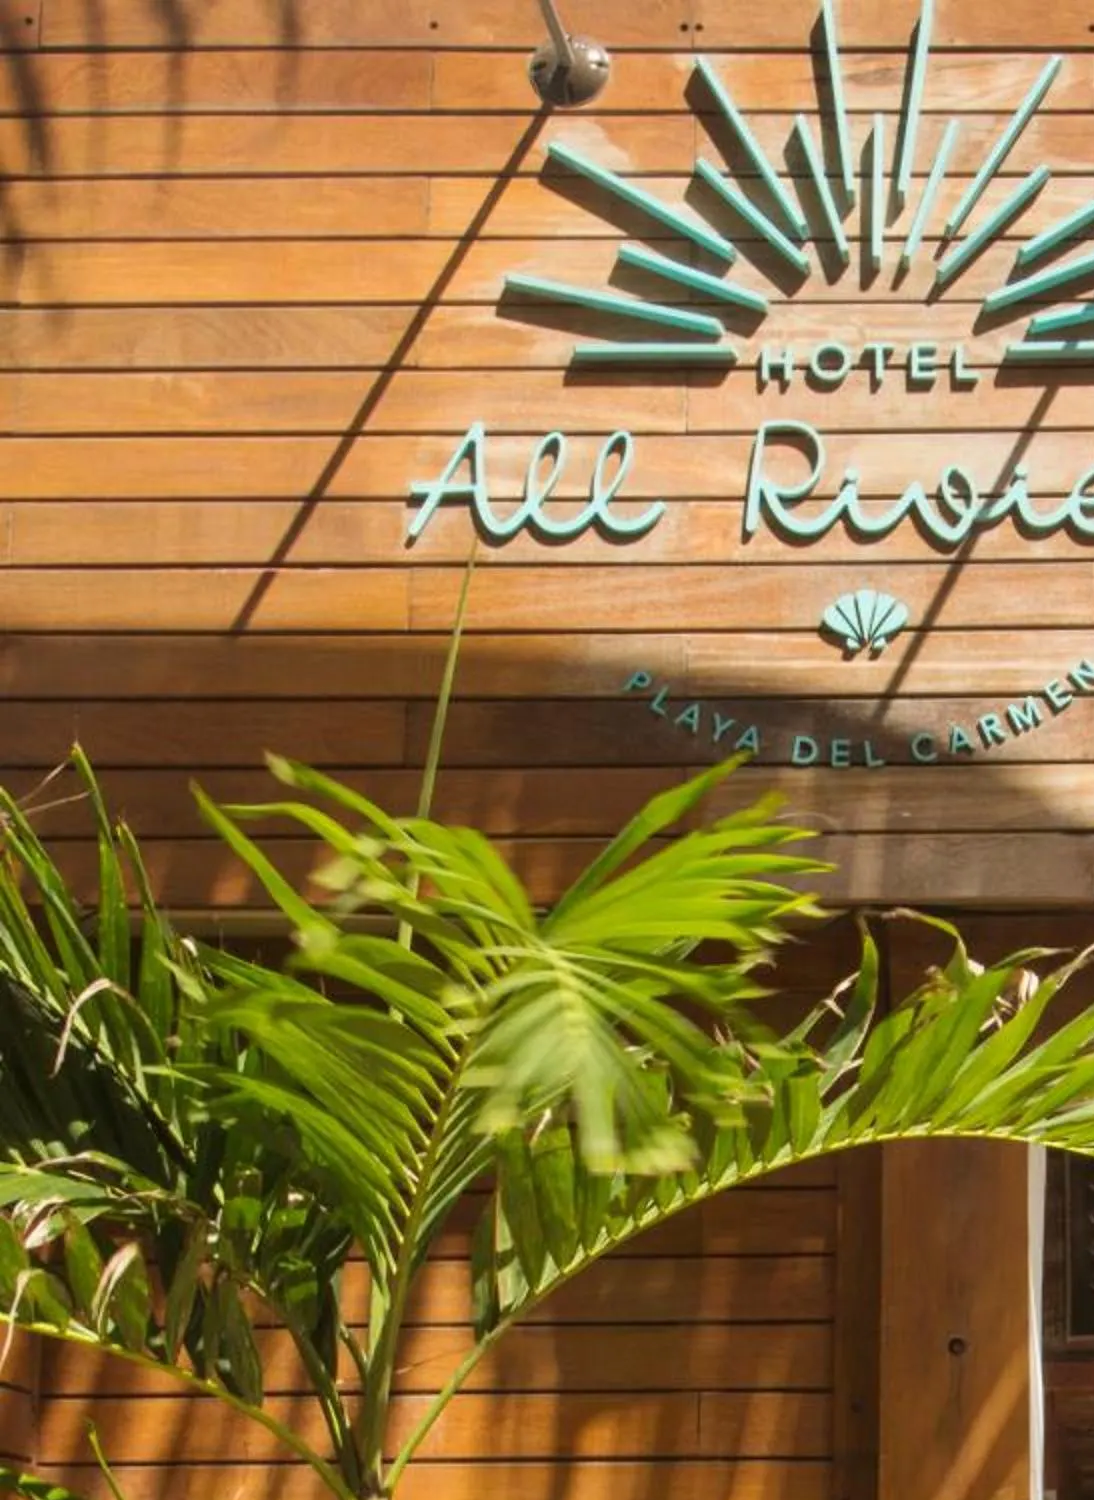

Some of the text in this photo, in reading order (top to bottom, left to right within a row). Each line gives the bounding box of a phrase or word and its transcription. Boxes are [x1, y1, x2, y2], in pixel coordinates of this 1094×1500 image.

[760, 343, 982, 384] HOTEL
[406, 420, 667, 548] All
[622, 670, 762, 757] PLAYA
[791, 734, 886, 768] DEL
